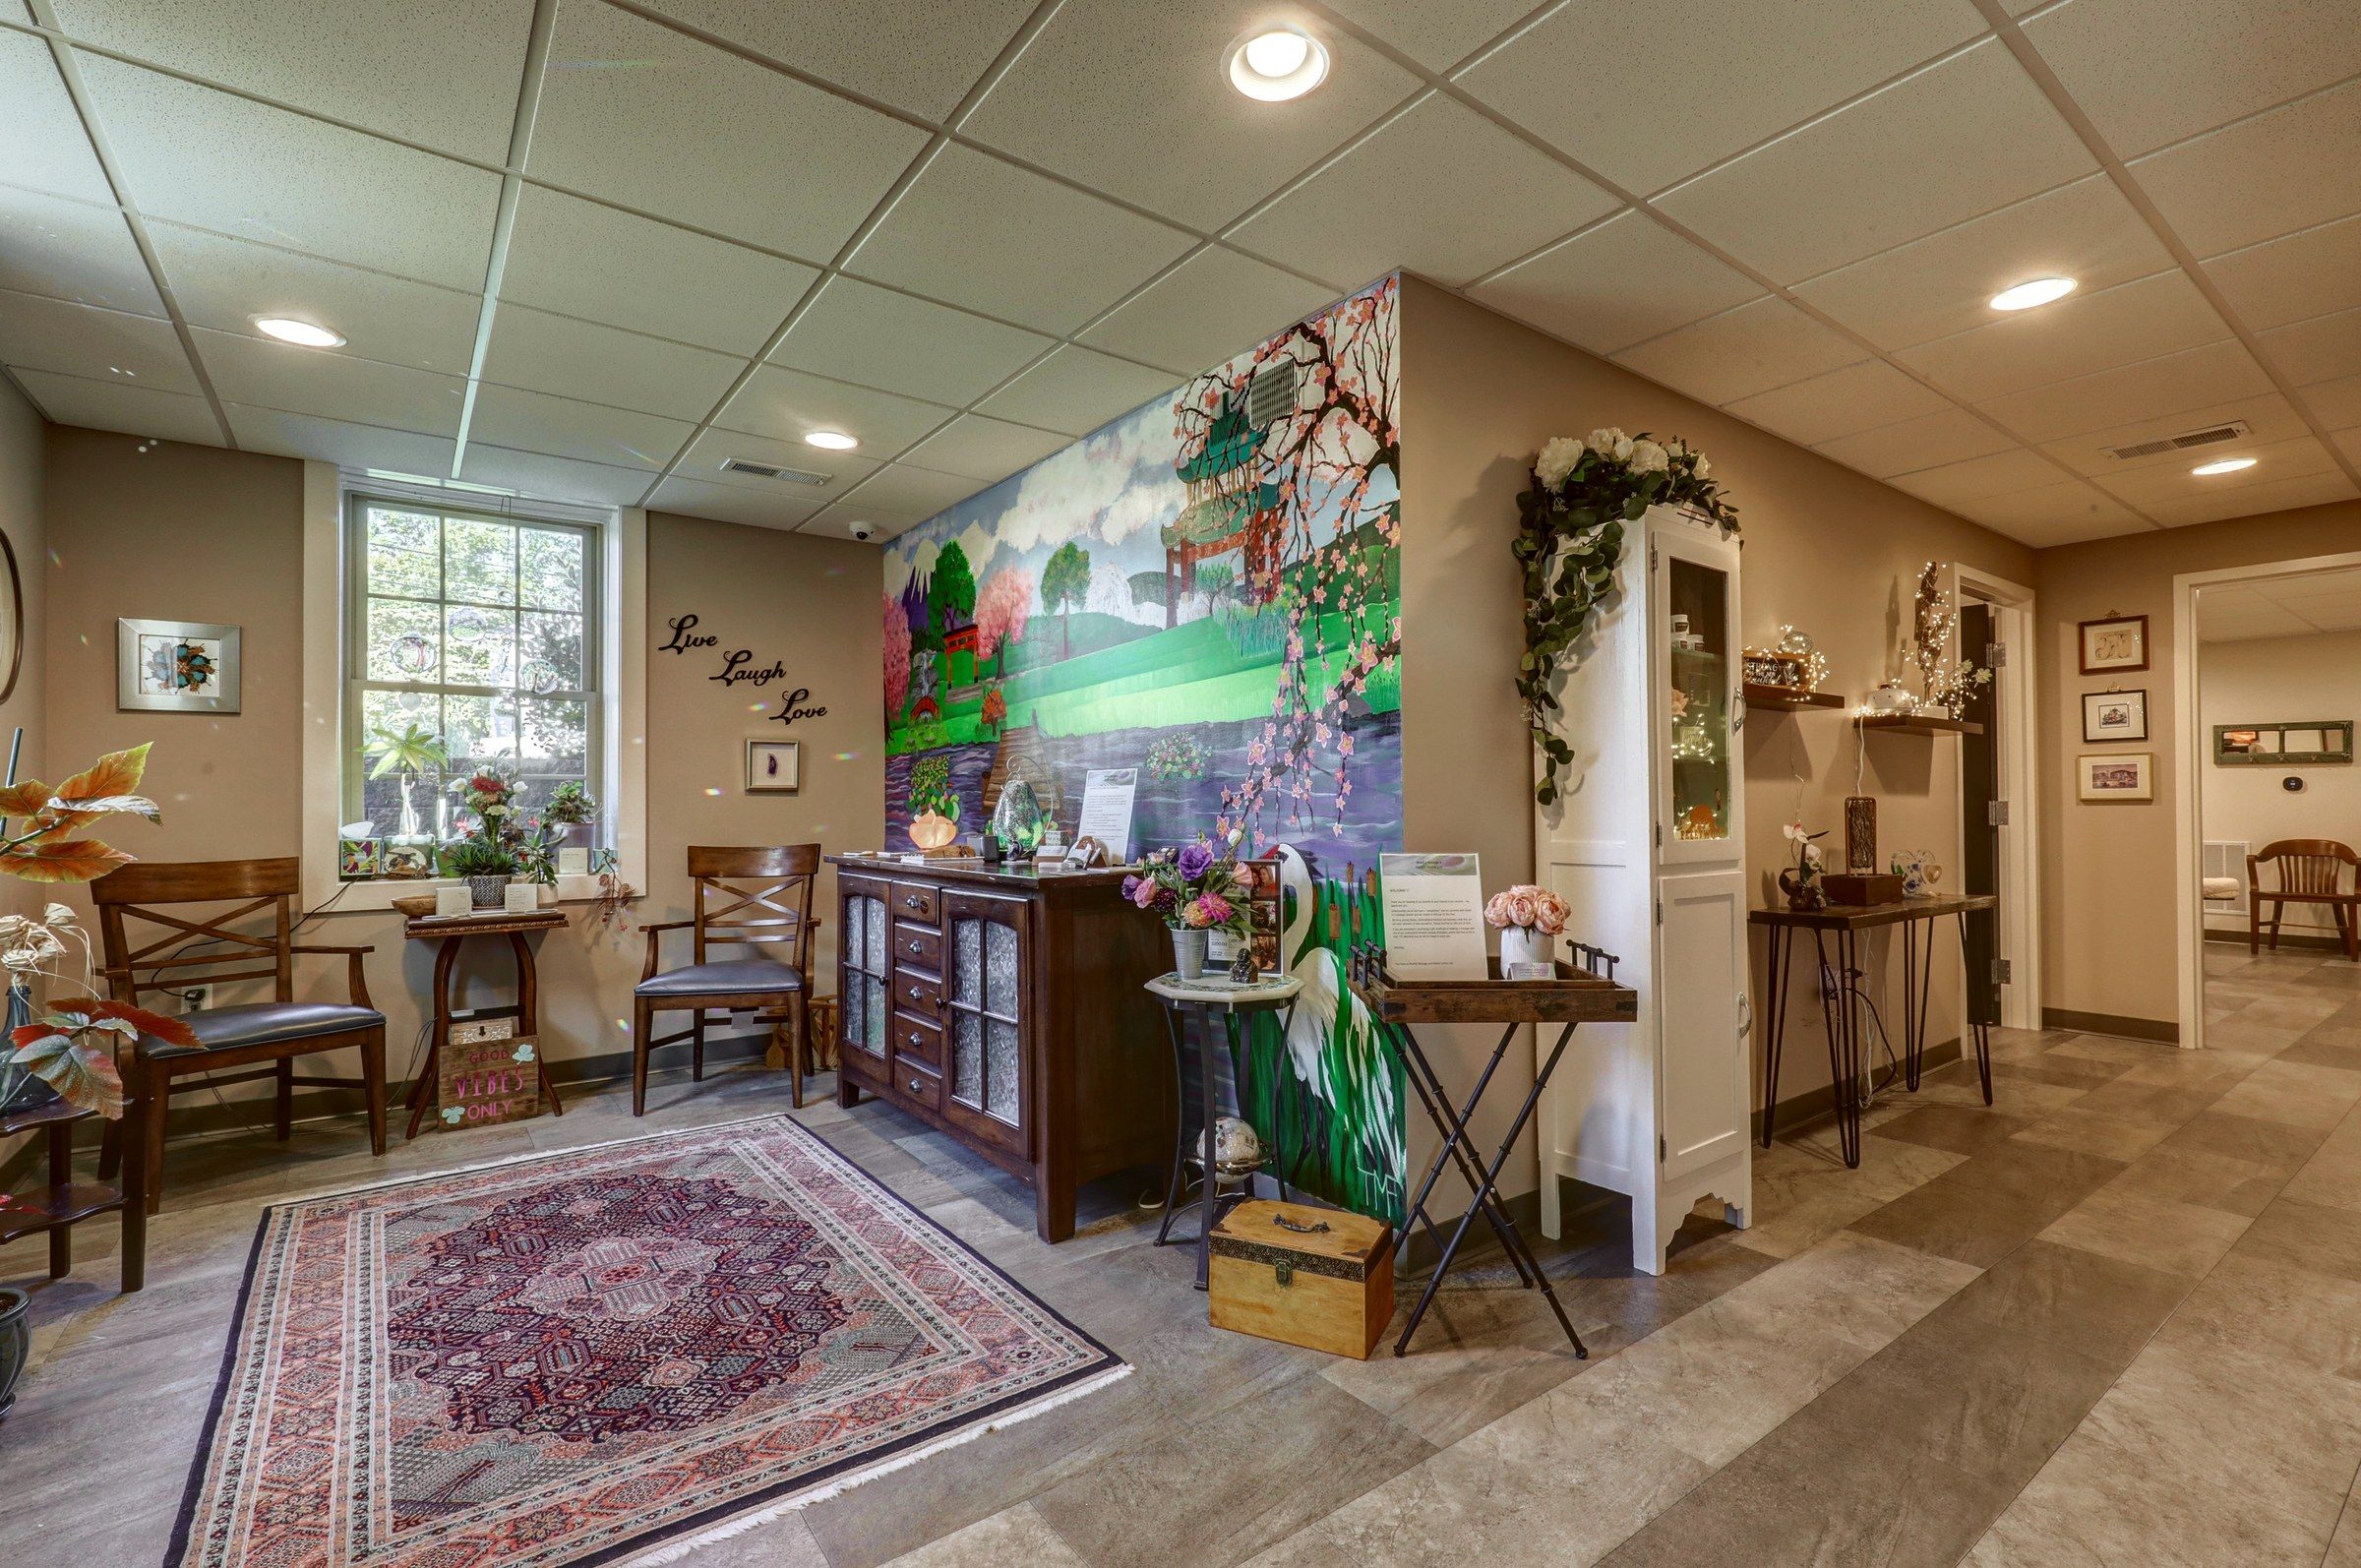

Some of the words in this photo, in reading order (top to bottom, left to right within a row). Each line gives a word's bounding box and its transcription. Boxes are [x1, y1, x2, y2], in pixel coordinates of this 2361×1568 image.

[658, 614, 718, 655] Live
[708, 649, 787, 687] Laugh
[1744, 675, 1783, 686] autifl
[1747, 662, 1779, 671] STRONG
[768, 689, 827, 726] Love
[468, 1049, 510, 1063] GOOD
[455, 1064, 524, 1100] VIBES
[467, 1099, 514, 1120] ONLY
